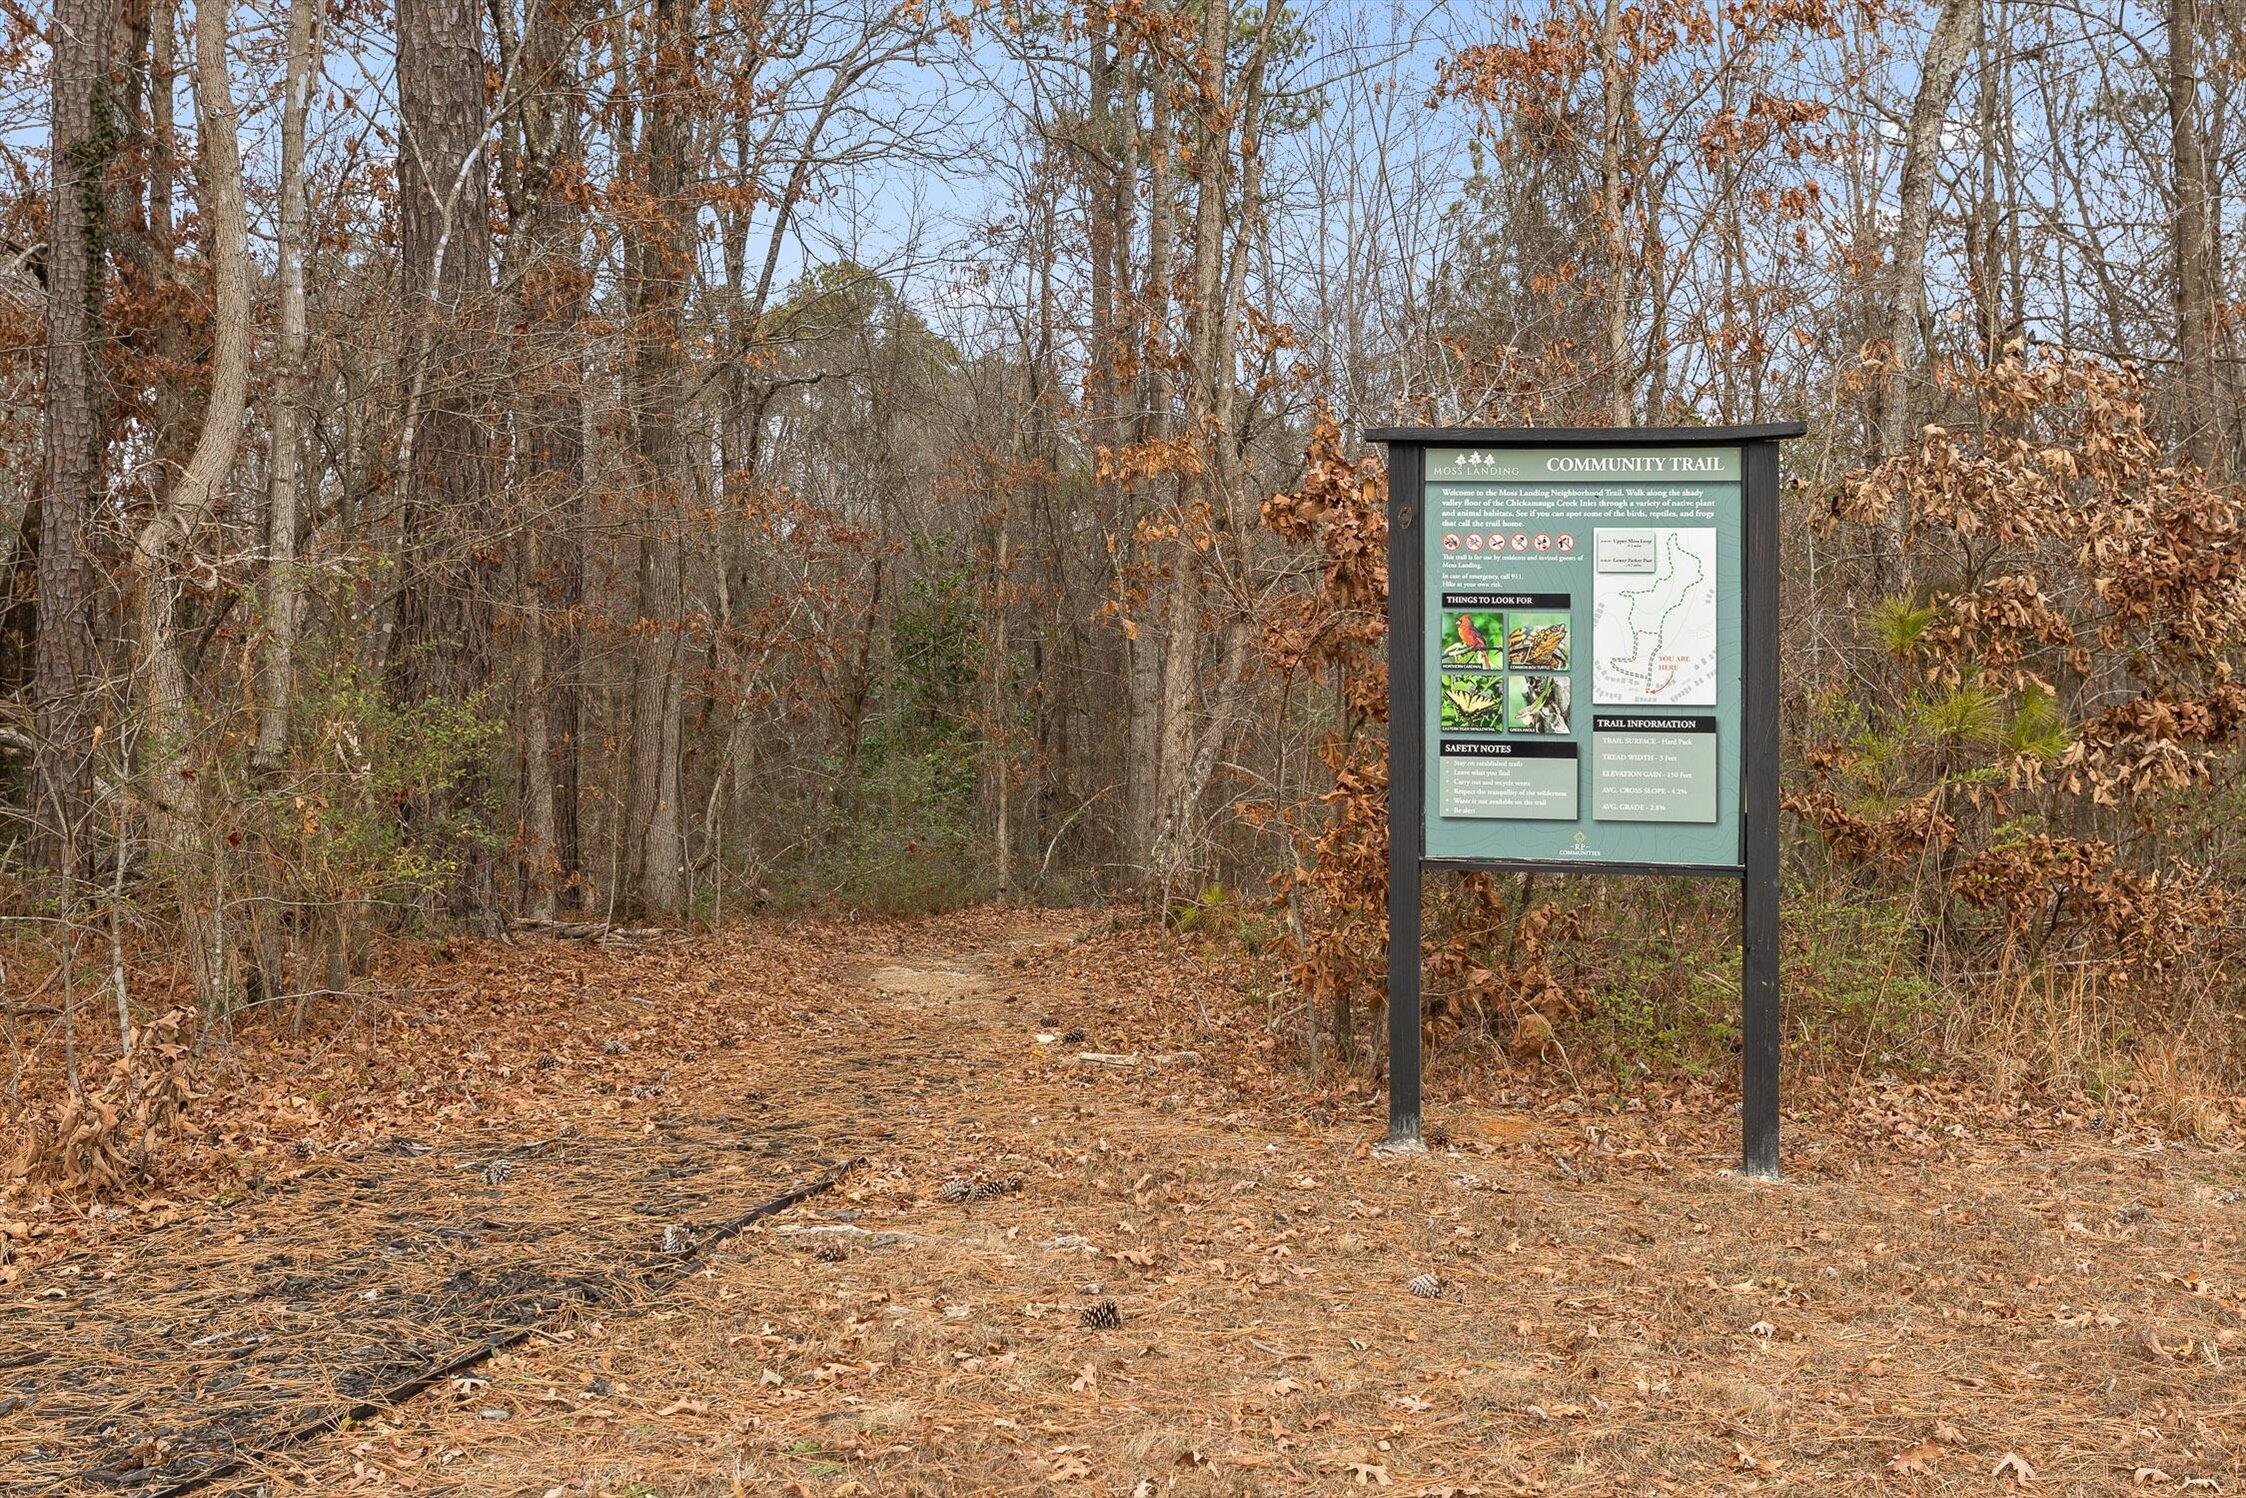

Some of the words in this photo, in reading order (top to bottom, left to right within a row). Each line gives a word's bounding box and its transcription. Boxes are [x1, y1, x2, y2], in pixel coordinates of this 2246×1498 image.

[1547, 457, 1667, 471] COMMUNITY
[1670, 457, 1724, 471] TRAIL
[1520, 489, 1550, 498] Landing
[1551, 489, 1603, 498] Neighborhood
[1647, 489, 1667, 498] along
[1682, 489, 1703, 498] shady
[1442, 500, 1462, 508] valley
[1506, 500, 1555, 508] Chickamauga
[1598, 500, 1628, 508] through
[1636, 500, 1660, 508] variety
[1695, 500, 1715, 508] plant
[1649, 510, 1678, 518] reptiles,
[1695, 510, 1714, 519] frogs
[1627, 720, 1696, 728] INFORMATION
[1445, 744, 1479, 752] SAFETY
[1480, 745, 1511, 753] NOTES
[1454, 779, 1470, 787] Carry
[1487, 789, 1517, 797] tranquility
